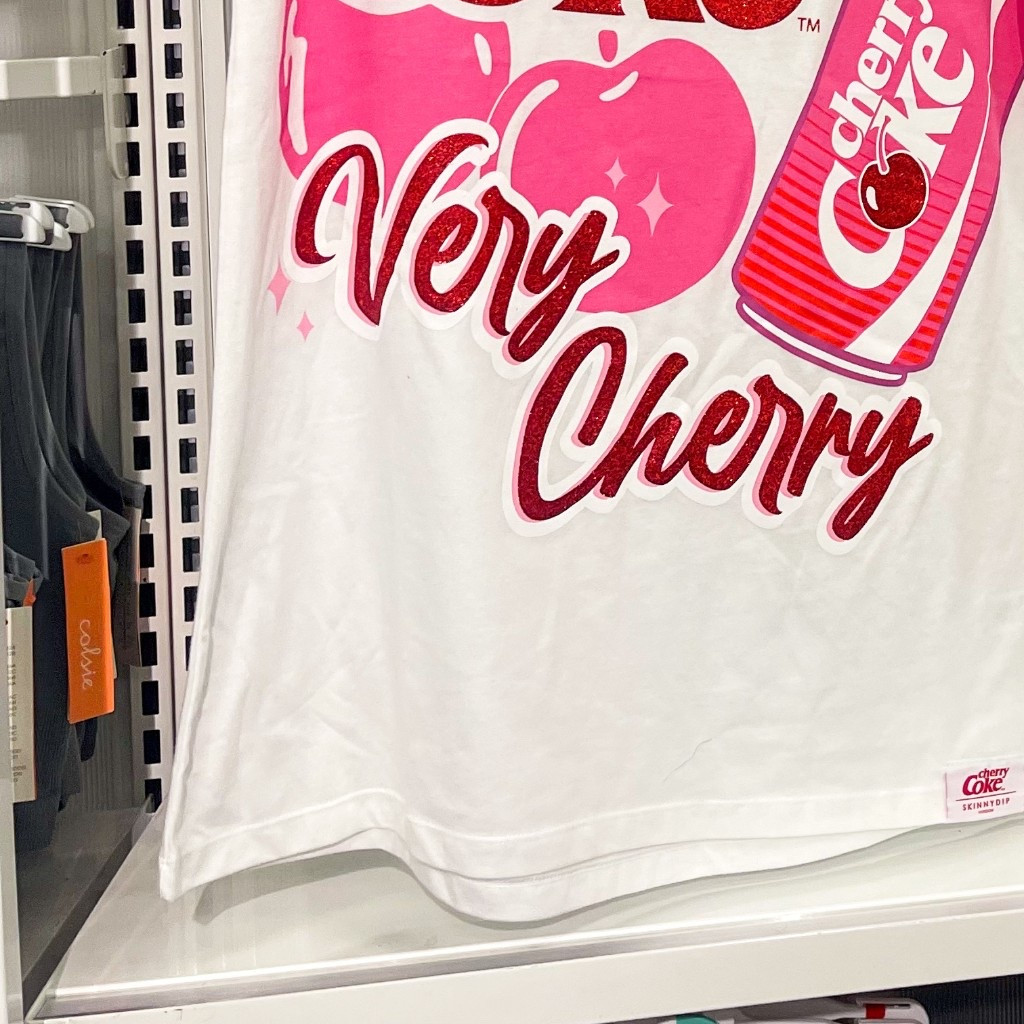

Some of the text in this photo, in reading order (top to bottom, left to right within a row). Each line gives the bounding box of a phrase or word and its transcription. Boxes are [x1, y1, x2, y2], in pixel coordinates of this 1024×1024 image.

[293, 132, 620, 364] Very
[510, 325, 935, 542] Cherry
[978, 767, 1010, 779] cherry
[962, 774, 1004, 796] Coke
[962, 797, 1011, 812] SKINNYDIP
